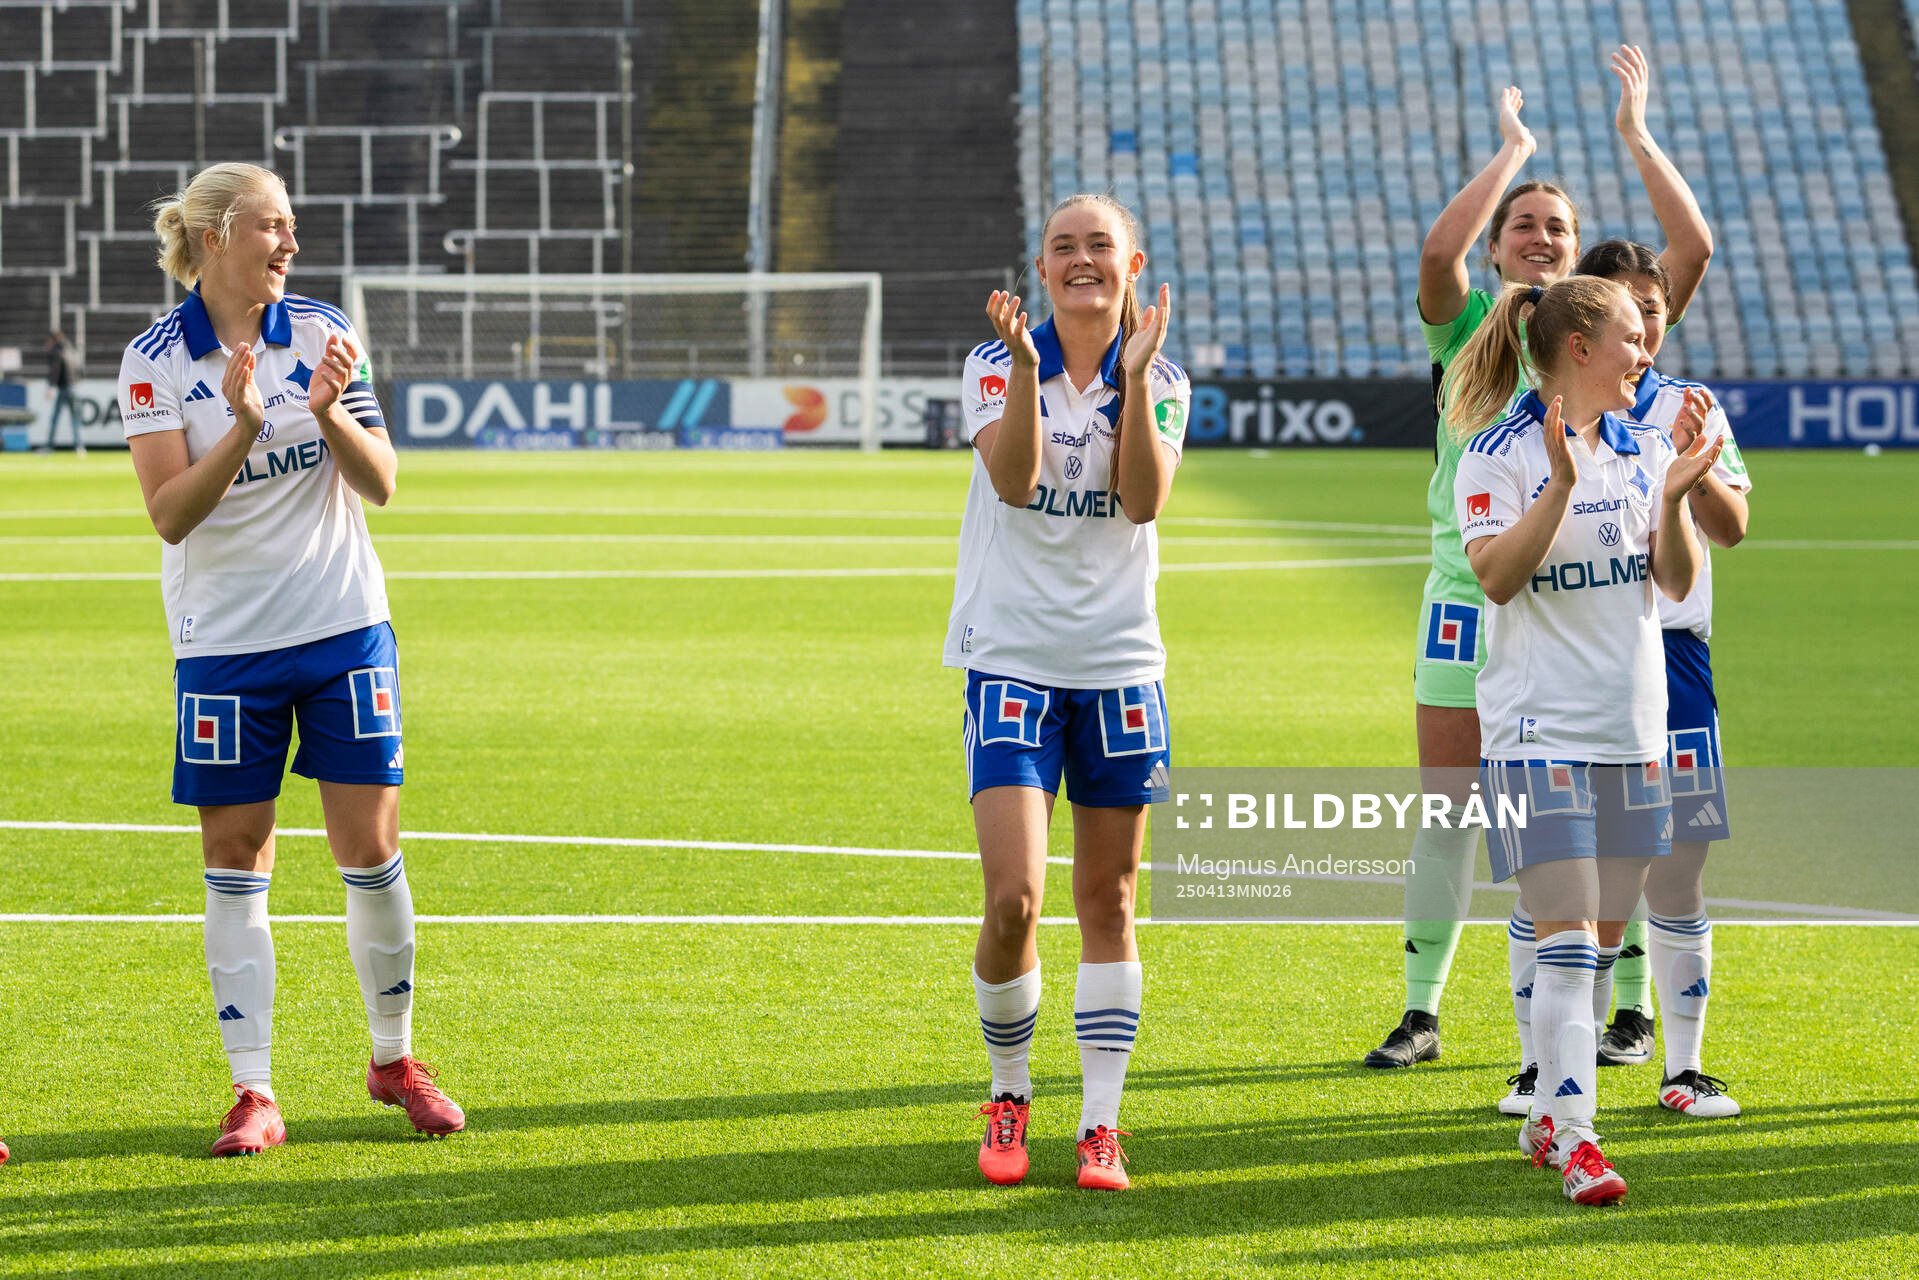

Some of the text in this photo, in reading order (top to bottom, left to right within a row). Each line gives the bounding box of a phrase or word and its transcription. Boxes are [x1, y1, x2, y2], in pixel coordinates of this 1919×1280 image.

[152, 409, 171, 418] SPEL
[407, 383, 645, 438] DAHL
[1573, 496, 1629, 515] stadium
[1486, 519, 1505, 527] SPEL
[1531, 553, 1648, 593] HOLME
